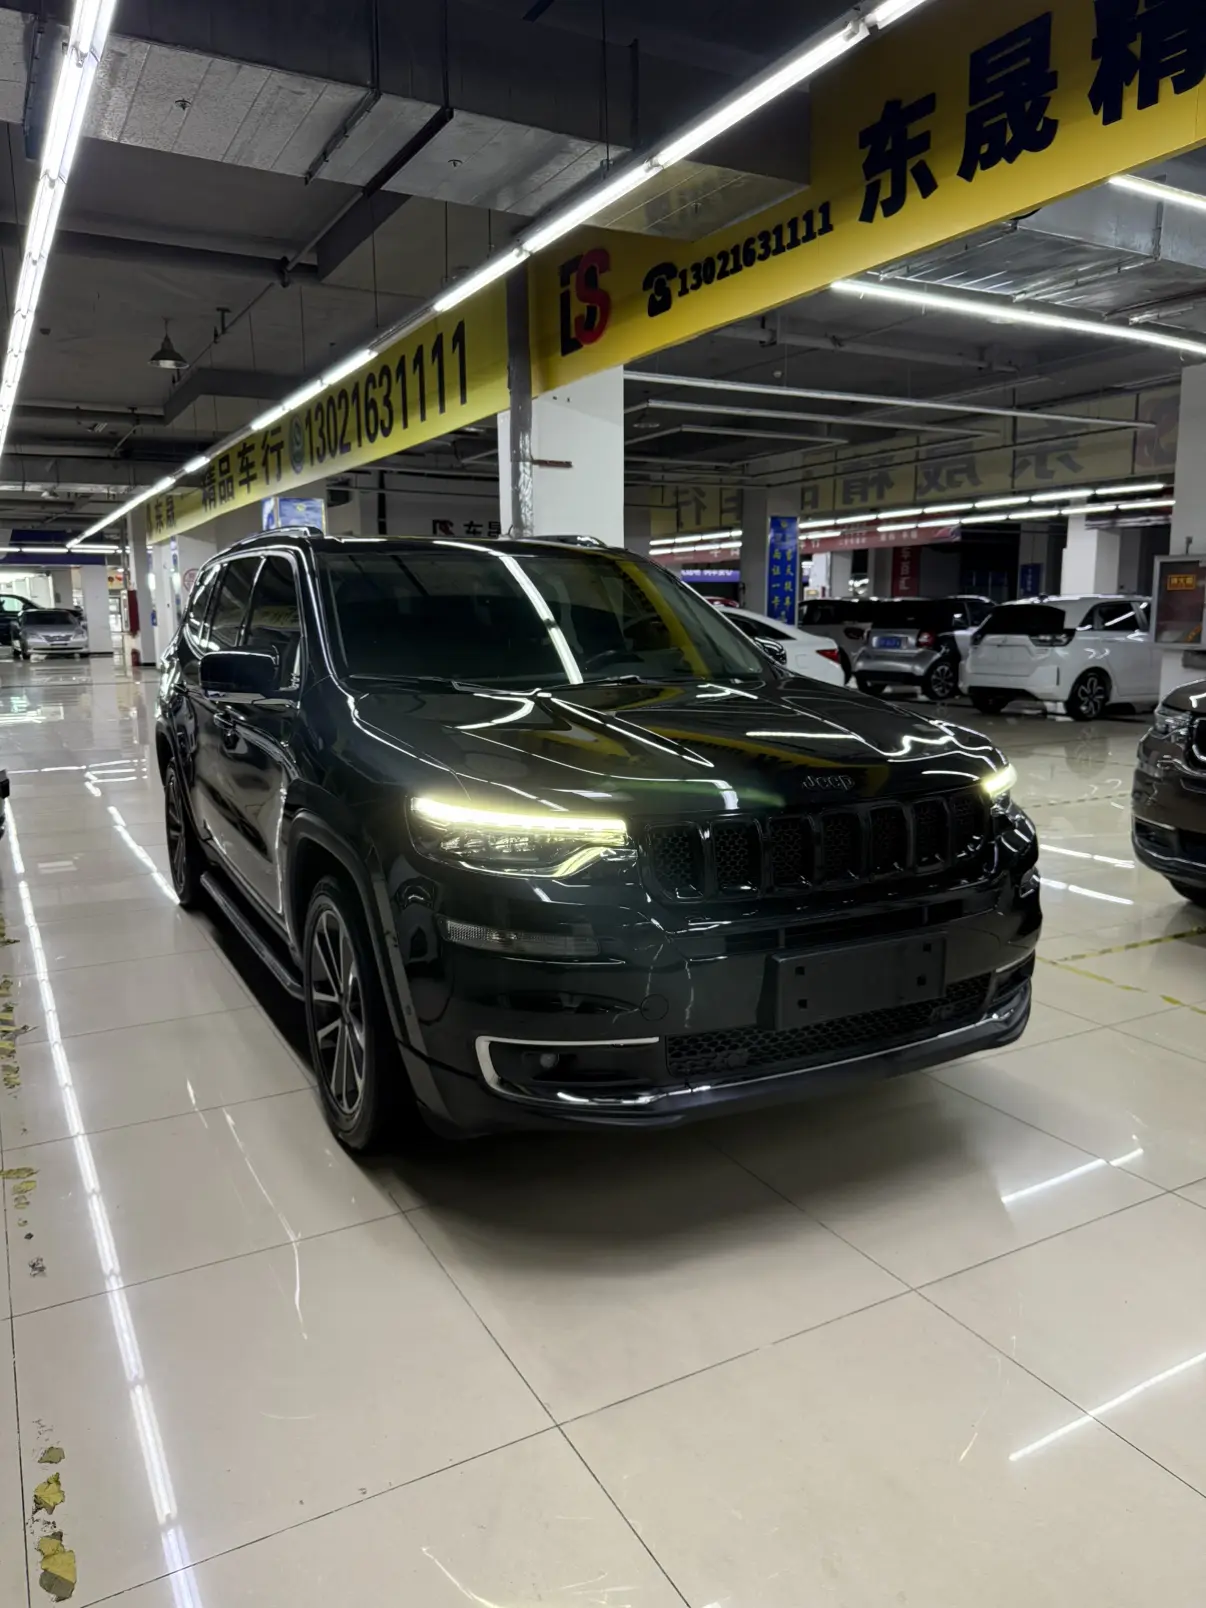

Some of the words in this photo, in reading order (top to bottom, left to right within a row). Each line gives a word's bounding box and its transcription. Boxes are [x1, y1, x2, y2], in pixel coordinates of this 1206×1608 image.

[677, 201, 835, 298] 13021631111
[201, 426, 285, 512] 精品车行
[305, 317, 468, 467] 13021631111
[802, 775, 856, 791] Jeep
